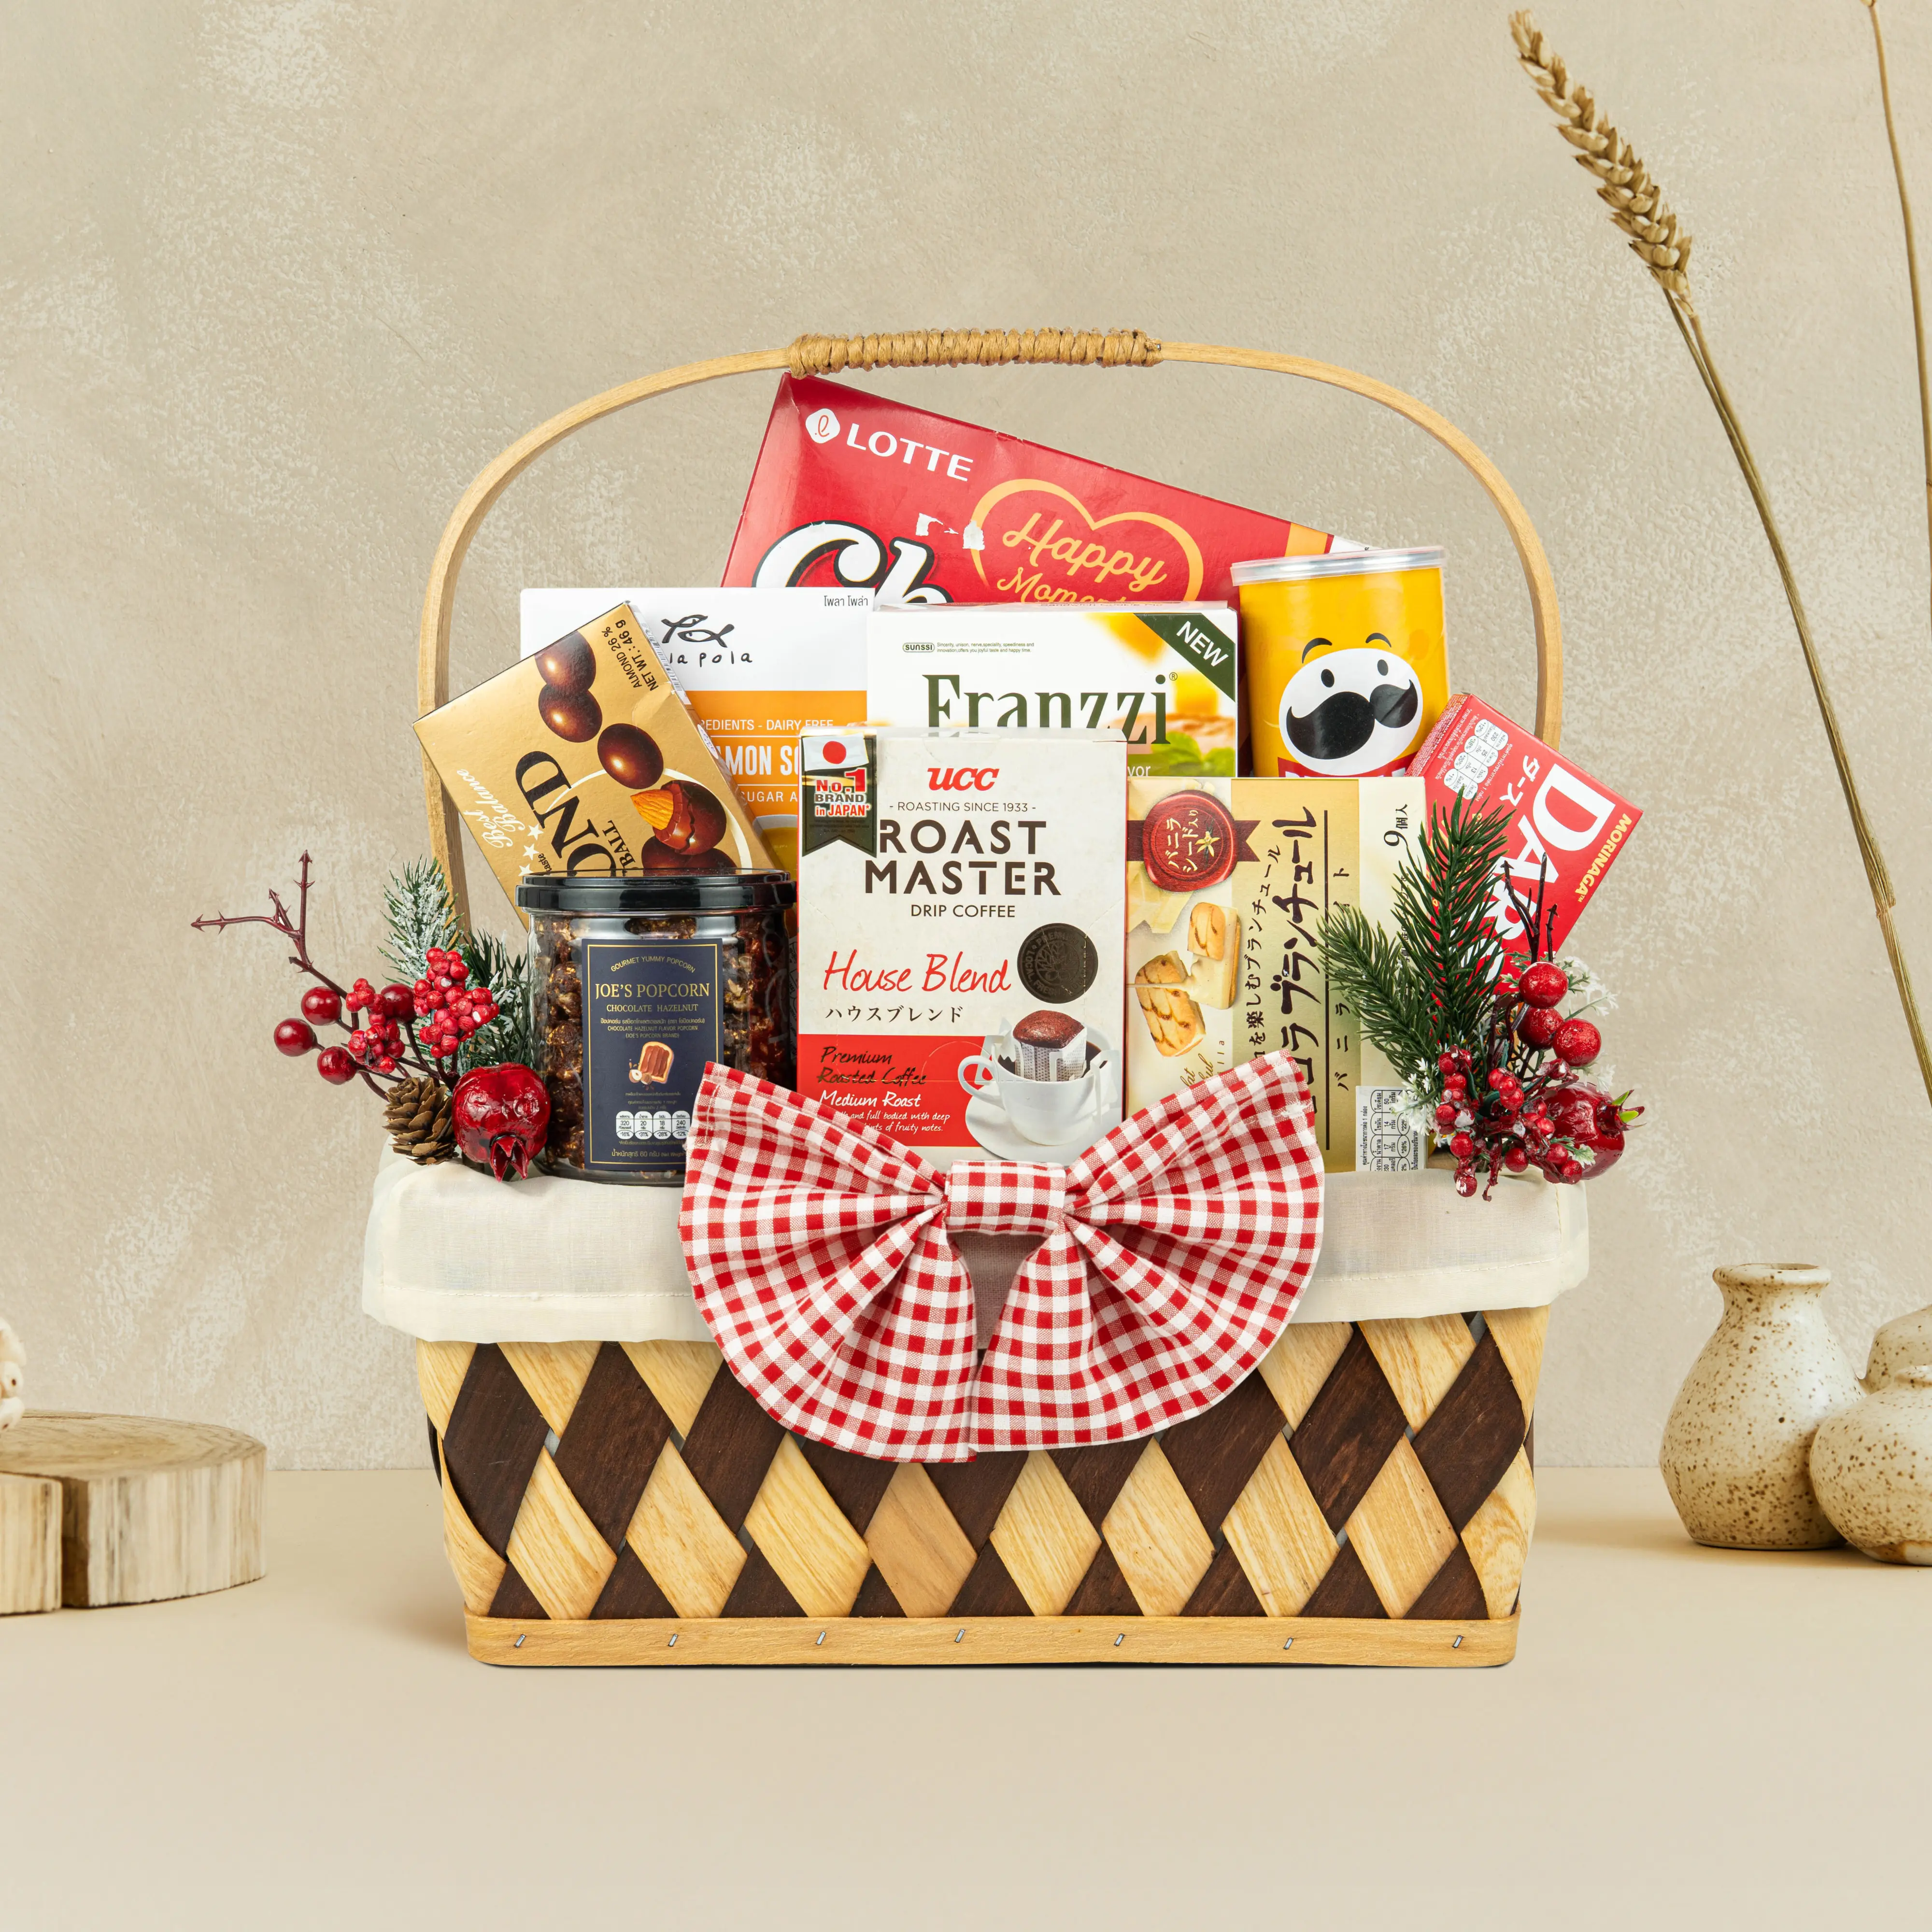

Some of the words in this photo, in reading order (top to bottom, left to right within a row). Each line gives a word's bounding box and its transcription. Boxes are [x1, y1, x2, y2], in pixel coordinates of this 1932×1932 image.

[847, 423, 974, 482] LOTTE
[1002, 512, 1167, 593] Happy
[824, 595, 844, 606] โพลา
[847, 595, 868, 606] โพล่า
[601, 626, 613, 638] %
[615, 619, 626, 629] g
[608, 638, 621, 652] 26
[619, 630, 633, 645] 46
[1176, 620, 1229, 667] NEW
[699, 651, 753, 668] pola
[617, 652, 642, 688] ALMOND
[641, 672, 659, 691] NET
[767, 720, 802, 730] DAIRY
[1490, 731, 1498, 741] 230
[780, 746, 798, 776] S
[816, 768, 866, 792] No.1
[1498, 753, 1543, 810] ダース
[456, 769, 526, 832] Balance
[815, 794, 864, 803] BRAND
[897, 802, 960, 812] ROASTING
[964, 802, 999, 812] SINCE
[1003, 803, 1028, 812] 1933
[815, 807, 825, 816] in
[463, 810, 513, 848] Best
[880, 819, 1047, 854] ROAST
[602, 820, 636, 869] BALL
[1165, 817, 1181, 869] バニラ
[1182, 809, 1199, 873] シード入り
[865, 860, 1062, 896] MASTER
[911, 905, 947, 918] DRIP
[952, 905, 1016, 918] COFFEE
[611, 957, 639, 972] GOURMET
[666, 957, 696, 973] POPCORN
[823, 949, 912, 992] House
[921, 951, 1011, 993] Blend
[637, 983, 710, 997] POPCORN
[824, 1005, 964, 1023] ハウスブレンド
[820, 1046, 893, 1065] Premium
[816, 1066, 876, 1084] Roasted
[881, 1066, 927, 1087] Coffee
[820, 1089, 878, 1107] Medium
[881, 1091, 922, 1107] Roast
[850, 1111, 865, 1120] and
[866, 1109, 881, 1121] full
[883, 1111, 908, 1120] bodied
[910, 1111, 930, 1120] with
[932, 1111, 951, 1125] deep
[885, 1122, 893, 1132] of
[895, 1121, 919, 1135] fruity
[921, 1123, 943, 1132] notes.
[1372, 1139, 1381, 1155] น้ำตาล
